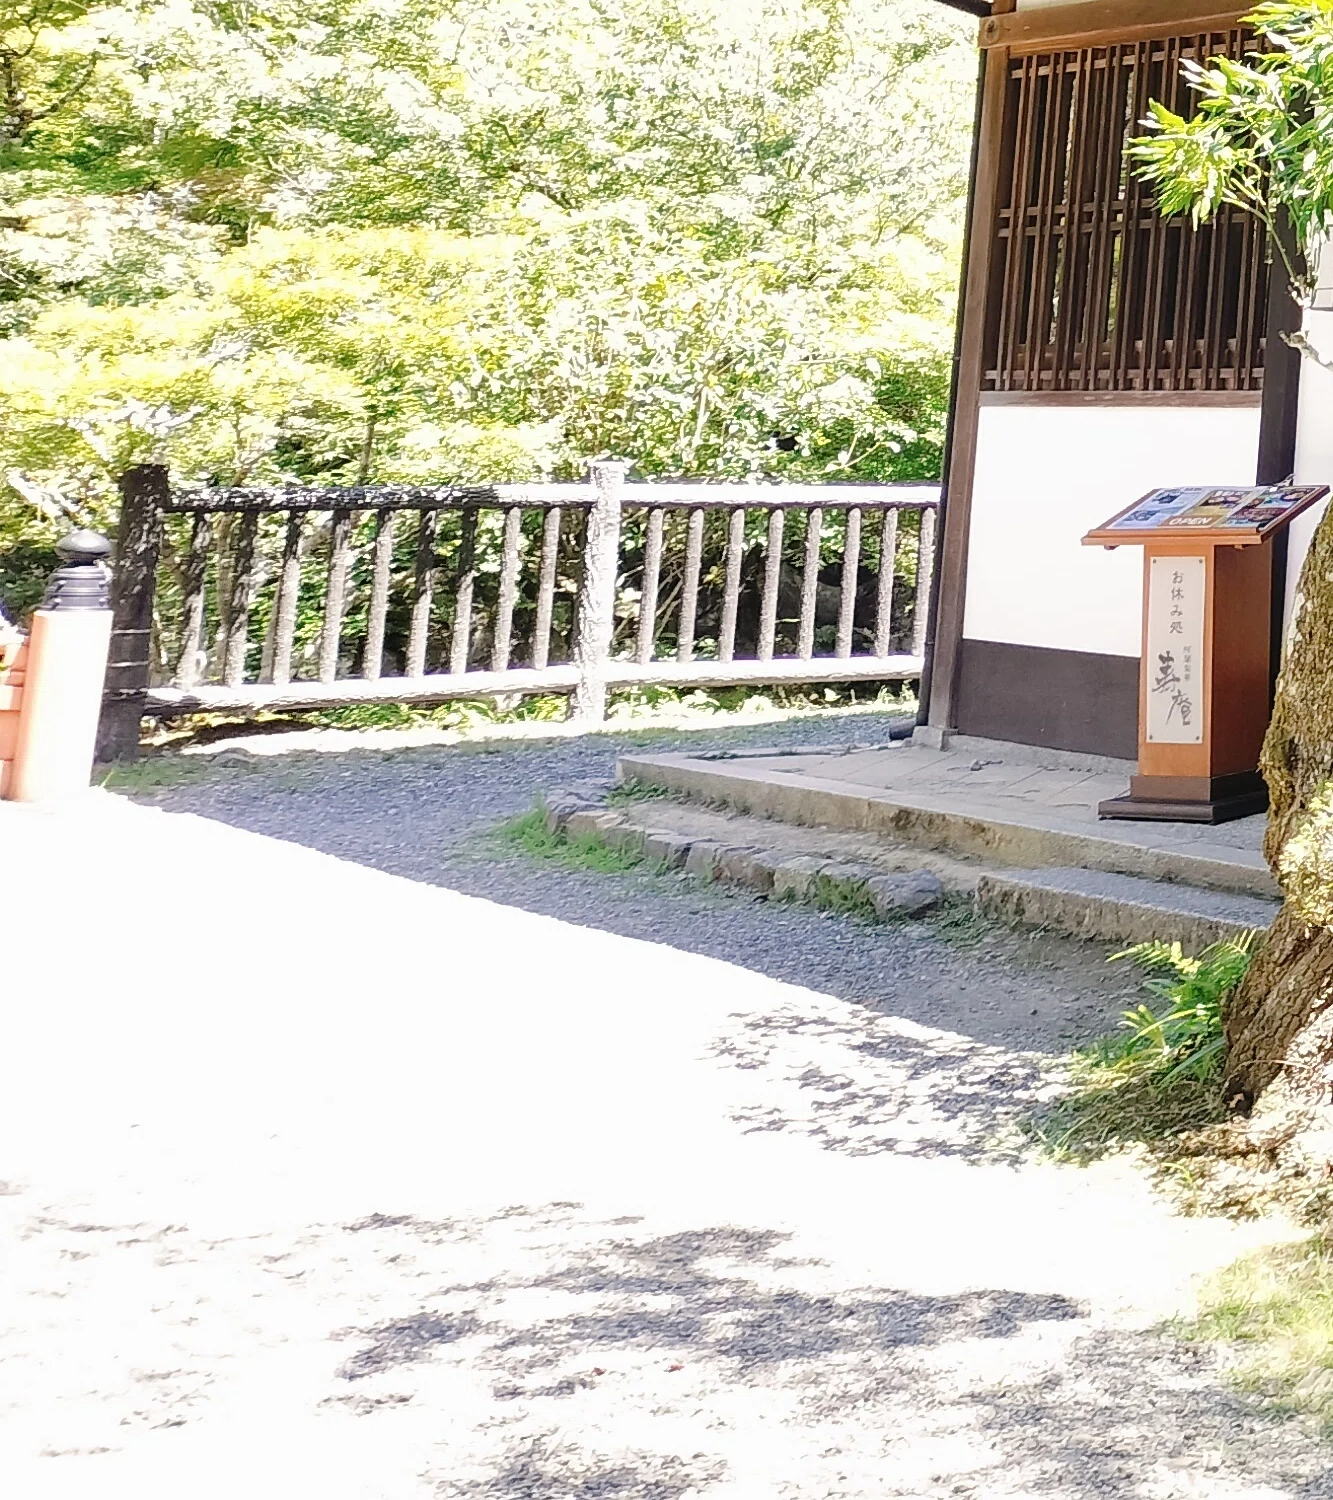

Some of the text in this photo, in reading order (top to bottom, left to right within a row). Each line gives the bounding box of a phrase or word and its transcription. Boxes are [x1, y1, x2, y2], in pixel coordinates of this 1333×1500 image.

[1169, 517, 1212, 526] OPEN
[1170, 571, 1184, 634] お休み処
